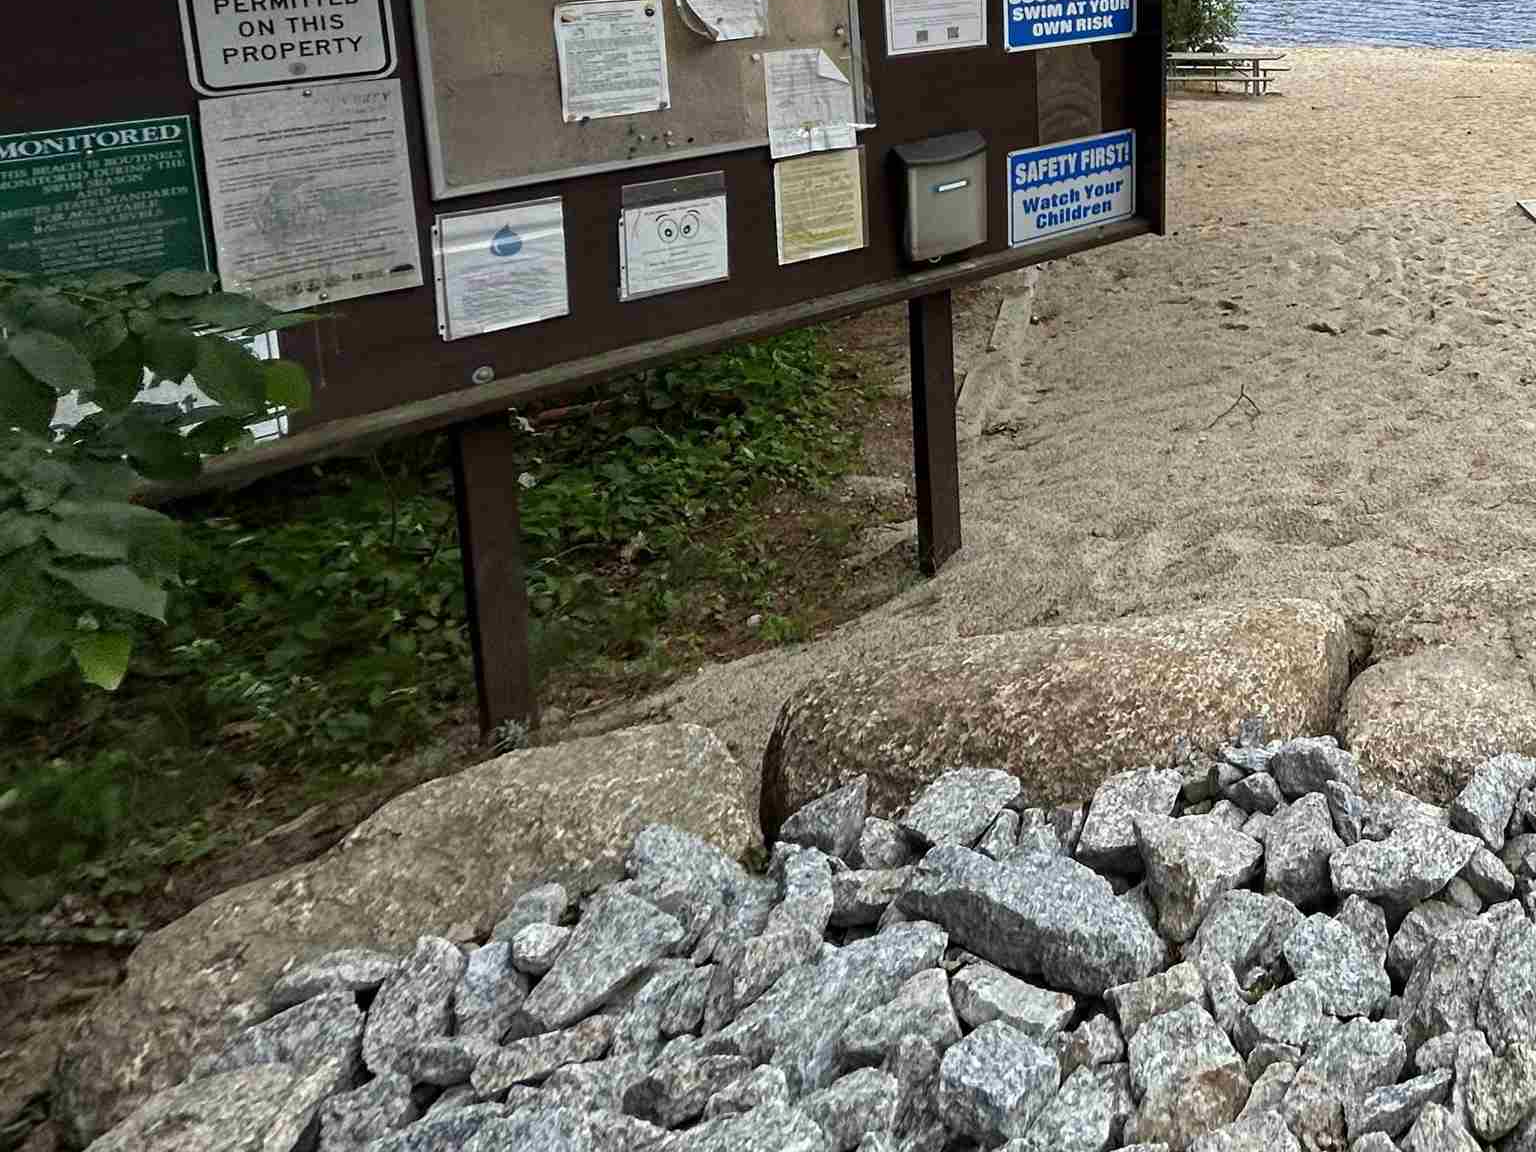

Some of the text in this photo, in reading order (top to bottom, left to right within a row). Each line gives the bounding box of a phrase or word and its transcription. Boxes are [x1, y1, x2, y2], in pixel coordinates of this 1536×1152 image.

[1012, 3, 1063, 21] SWIM
[1067, 1, 1086, 16] AT
[238, 14, 344, 38] ON THIS
[1032, 15, 1113, 37] OWN RISK
[222, 35, 363, 65] PROPERTY
[0, 124, 182, 160] MONITORED
[32, 161, 82, 176] BEACH
[104, 149, 183, 166] ROUTINELY
[1015, 141, 1130, 185] SAFETY FIRST!
[1022, 179, 1123, 215] Watch Your
[1036, 200, 1112, 229] Children
